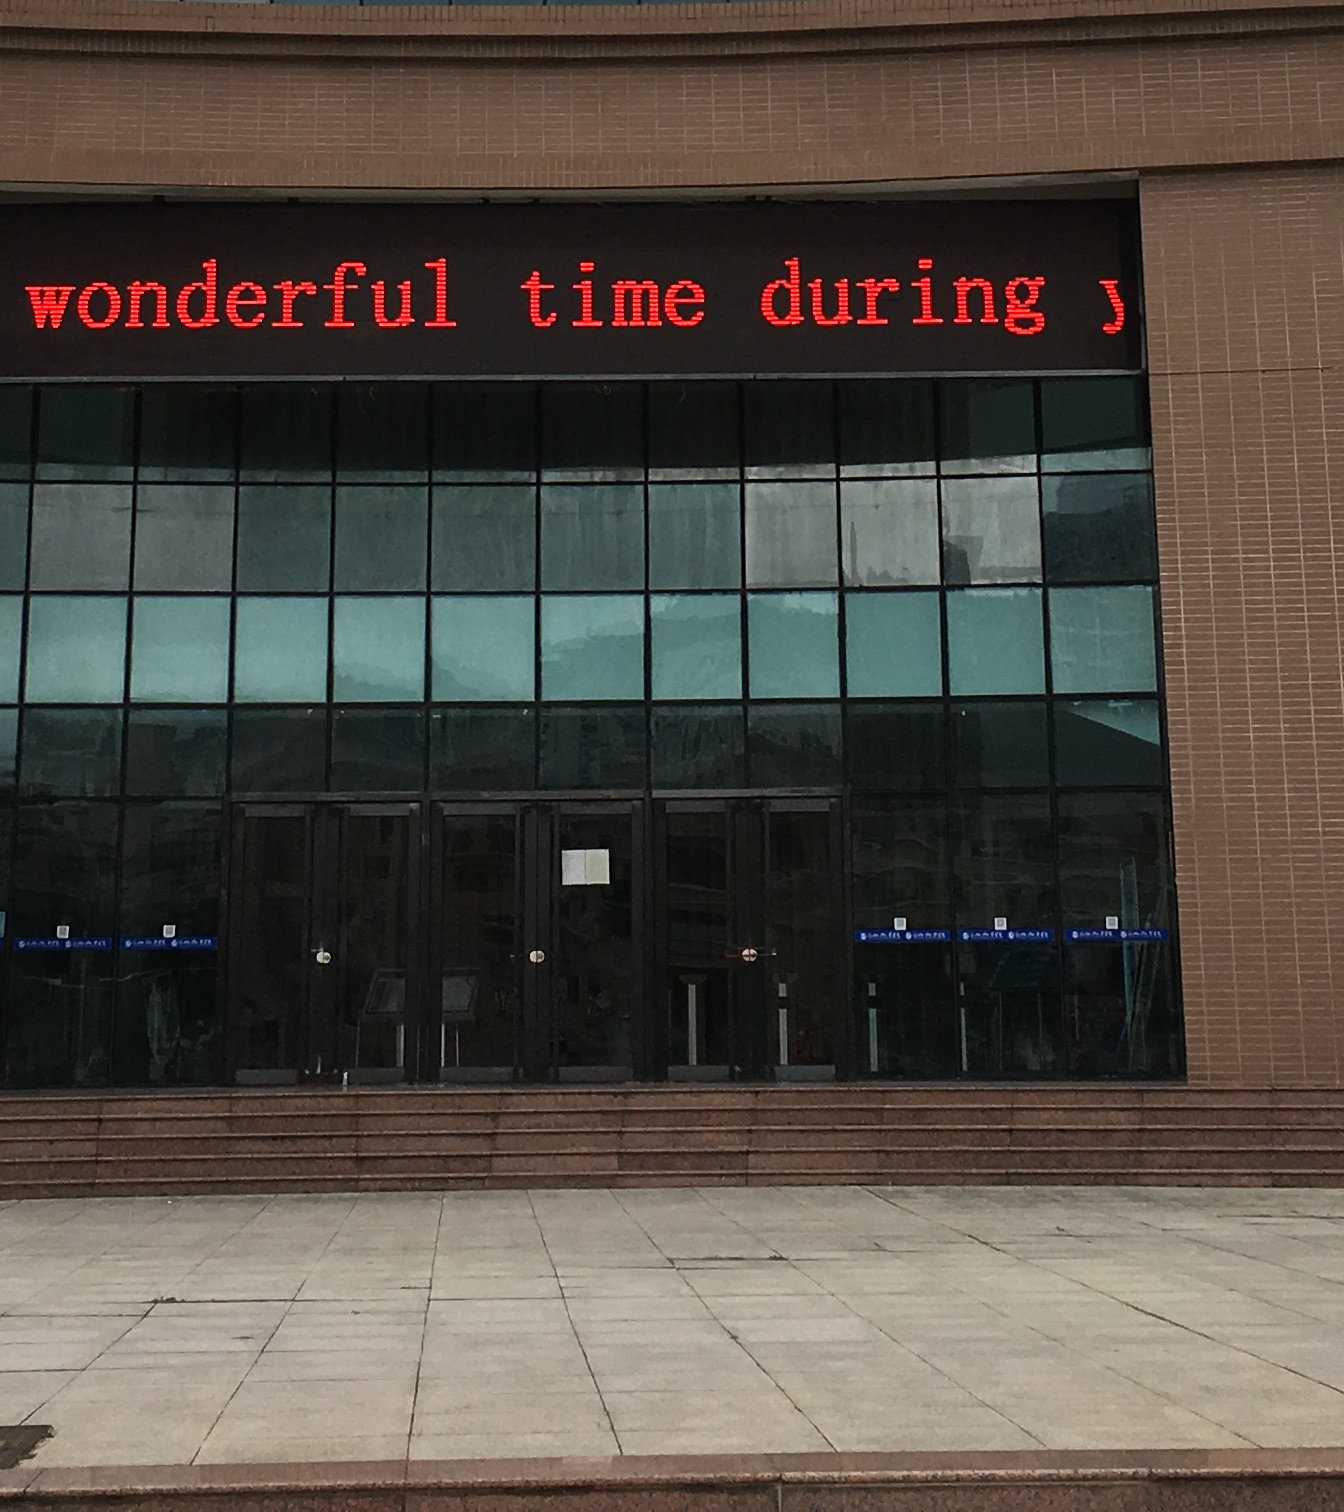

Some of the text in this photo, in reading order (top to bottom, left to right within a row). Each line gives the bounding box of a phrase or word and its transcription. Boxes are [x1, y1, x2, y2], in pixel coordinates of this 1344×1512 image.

[25, 257, 457, 329] wonderful
[520, 261, 706, 328] time
[760, 257, 1047, 335] during
